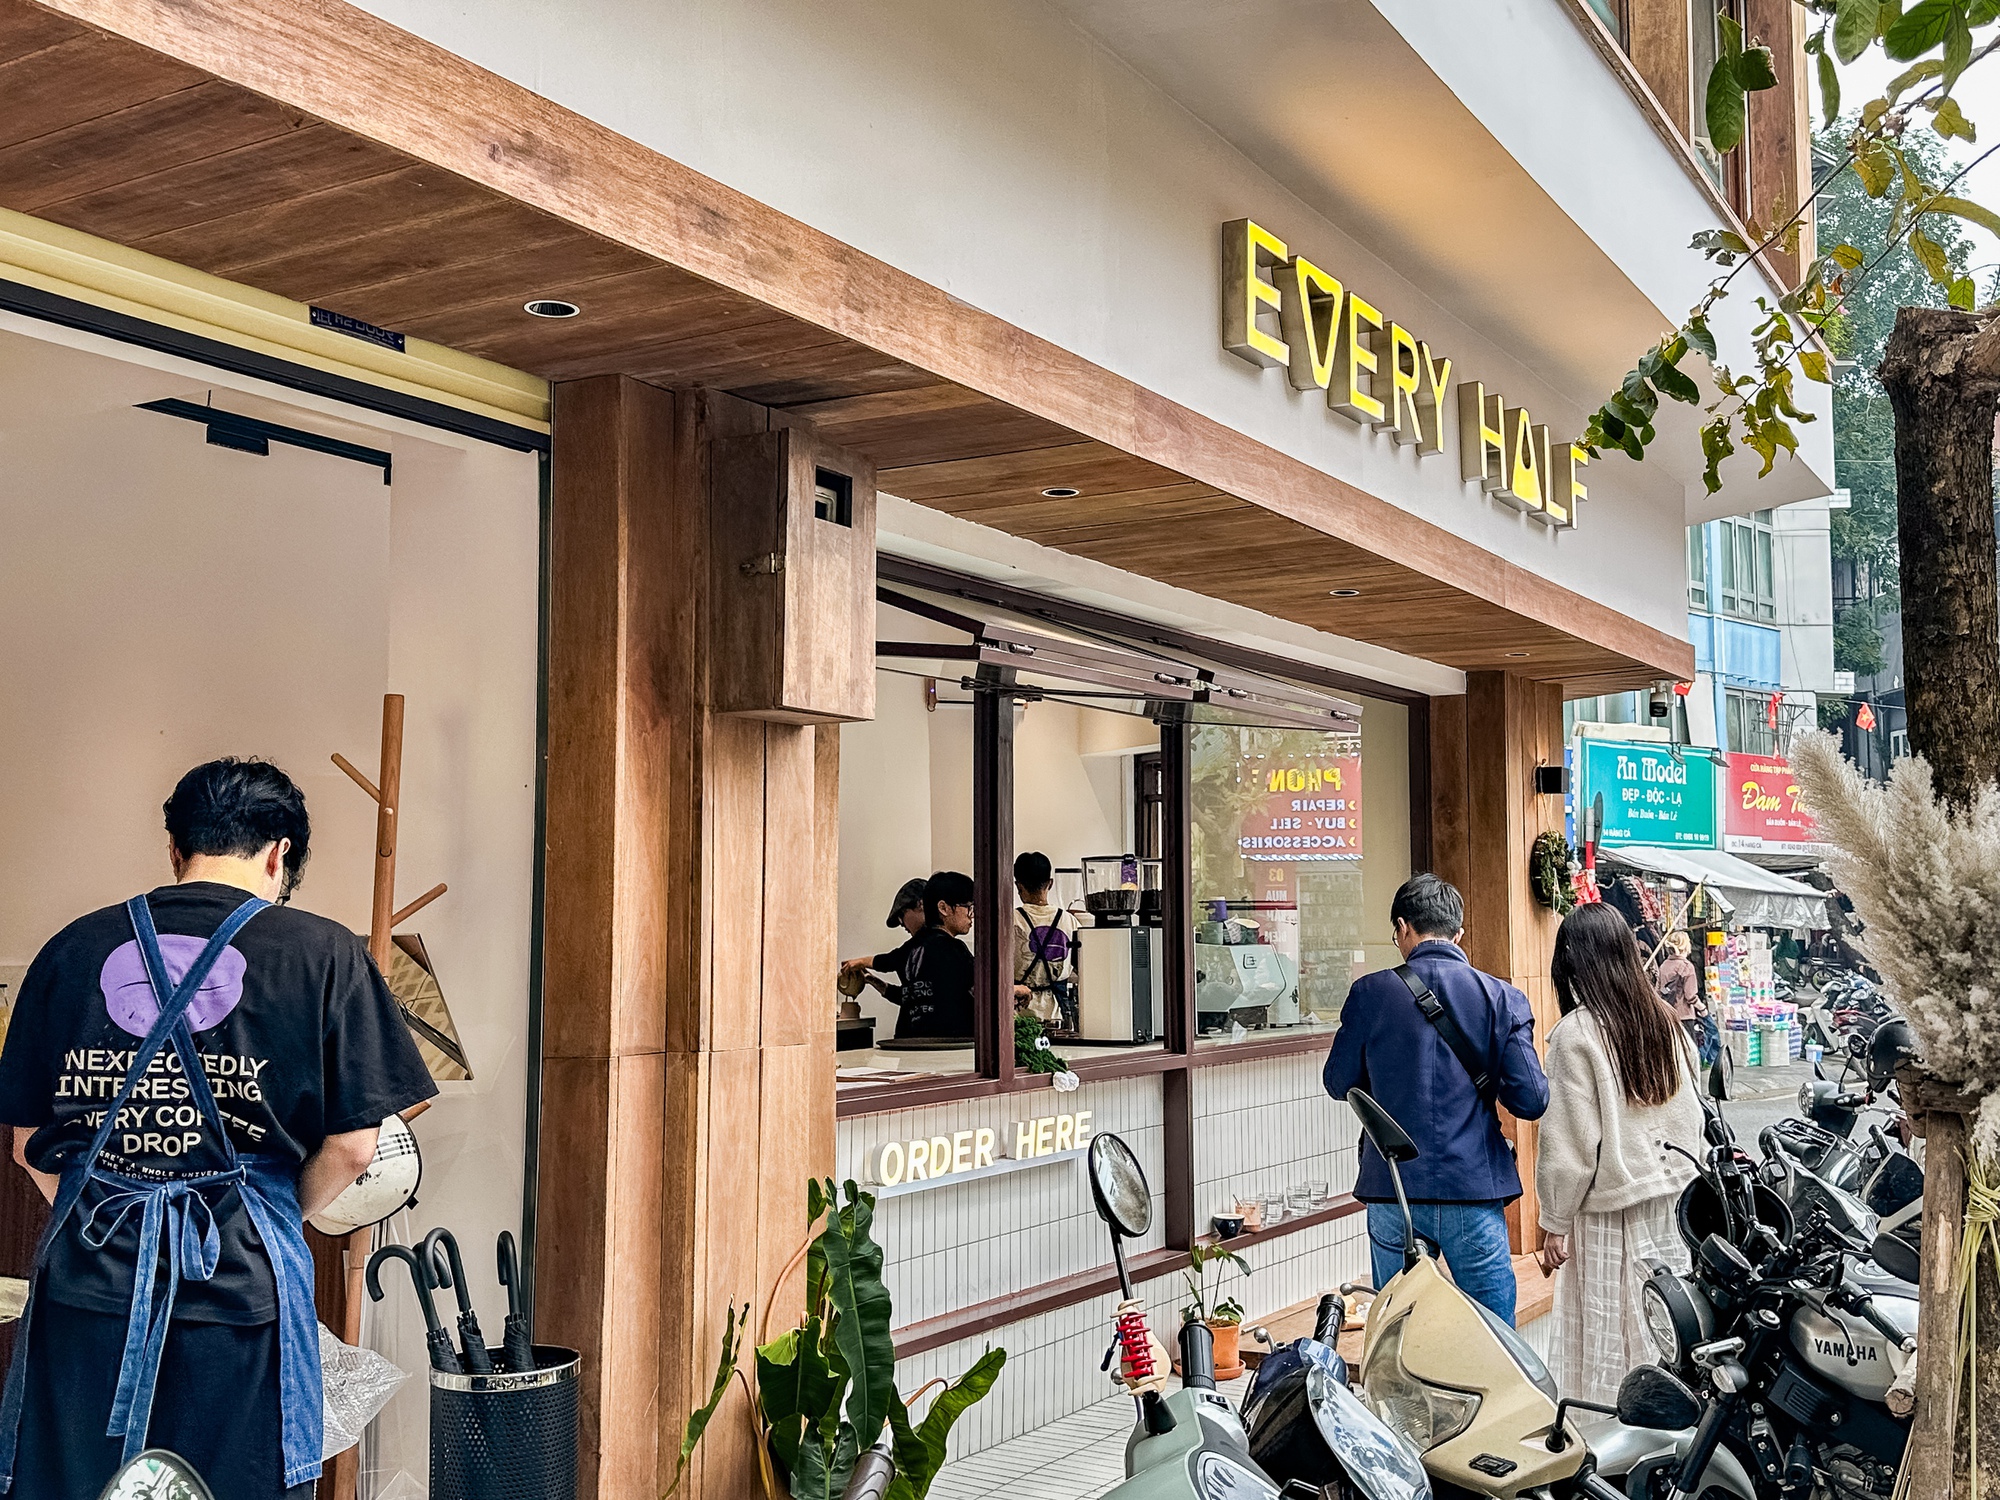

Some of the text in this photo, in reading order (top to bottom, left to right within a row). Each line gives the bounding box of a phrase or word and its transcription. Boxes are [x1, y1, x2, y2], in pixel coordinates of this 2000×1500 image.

[1245, 218, 1590, 531] EVERY HALF
[1616, 755, 1687, 785] An Model
[1621, 787, 1640, 804] ĐẸP
[1671, 791, 1683, 808] LẠ
[1741, 781, 1782, 812] Đàm
[65, 1049, 269, 1079] NEXECEDLY
[55, 1075, 263, 1102] INTERESING
[64, 1106, 150, 1130] VERY
[123, 1131, 202, 1157] DROP
[877, 1109, 1093, 1188] ORDER HERE
[141, 1166, 175, 1177] WHOLE
[1814, 1338, 1878, 1361] YAMAHA
